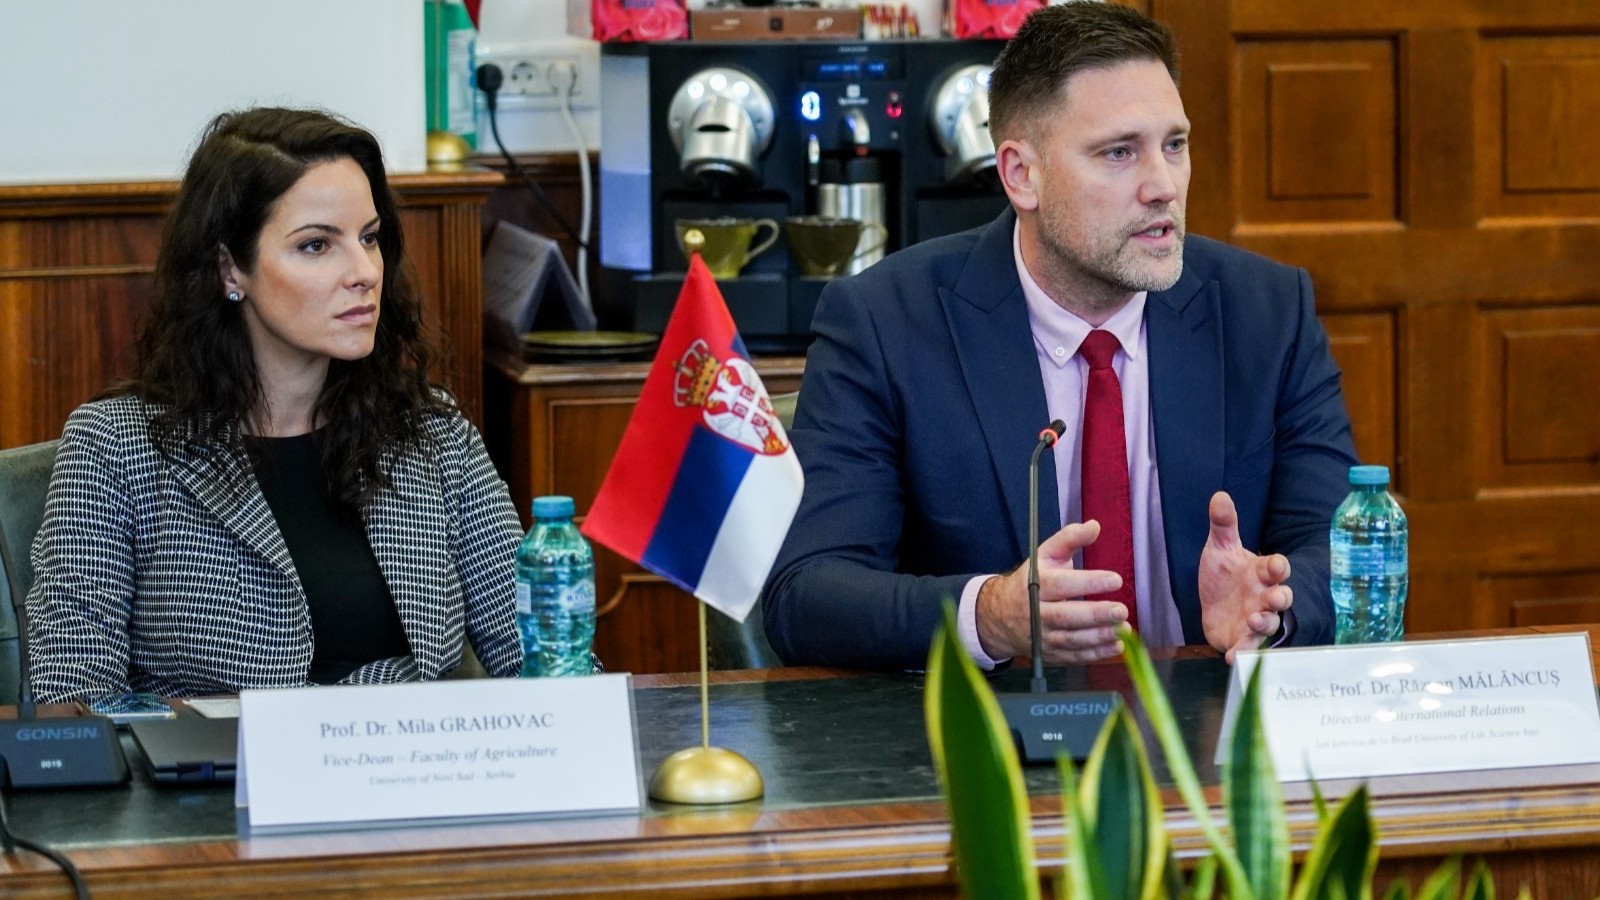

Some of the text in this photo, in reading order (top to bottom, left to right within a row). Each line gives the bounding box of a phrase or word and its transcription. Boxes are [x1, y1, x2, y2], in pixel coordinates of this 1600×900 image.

[1276, 686, 1325, 701] Assoc.
[1329, 681, 1366, 698] Prof.
[1370, 679, 1395, 696] Dr.
[1030, 703, 1109, 716] GONSIN
[1320, 712, 1371, 726] Director
[1470, 704, 1526, 718] Relations
[16, 726, 98, 741] GONSIN
[320, 712, 554, 738] Prof. Dr. Mila GRAHOVAC
[1042, 732, 1063, 741] 0018
[323, 752, 394, 767] Vice-Dean
[410, 748, 460, 764] Faculty
[464, 747, 479, 763] of
[481, 744, 558, 762] Agriculture
[369, 775, 417, 786] University
[420, 773, 431, 785] of
